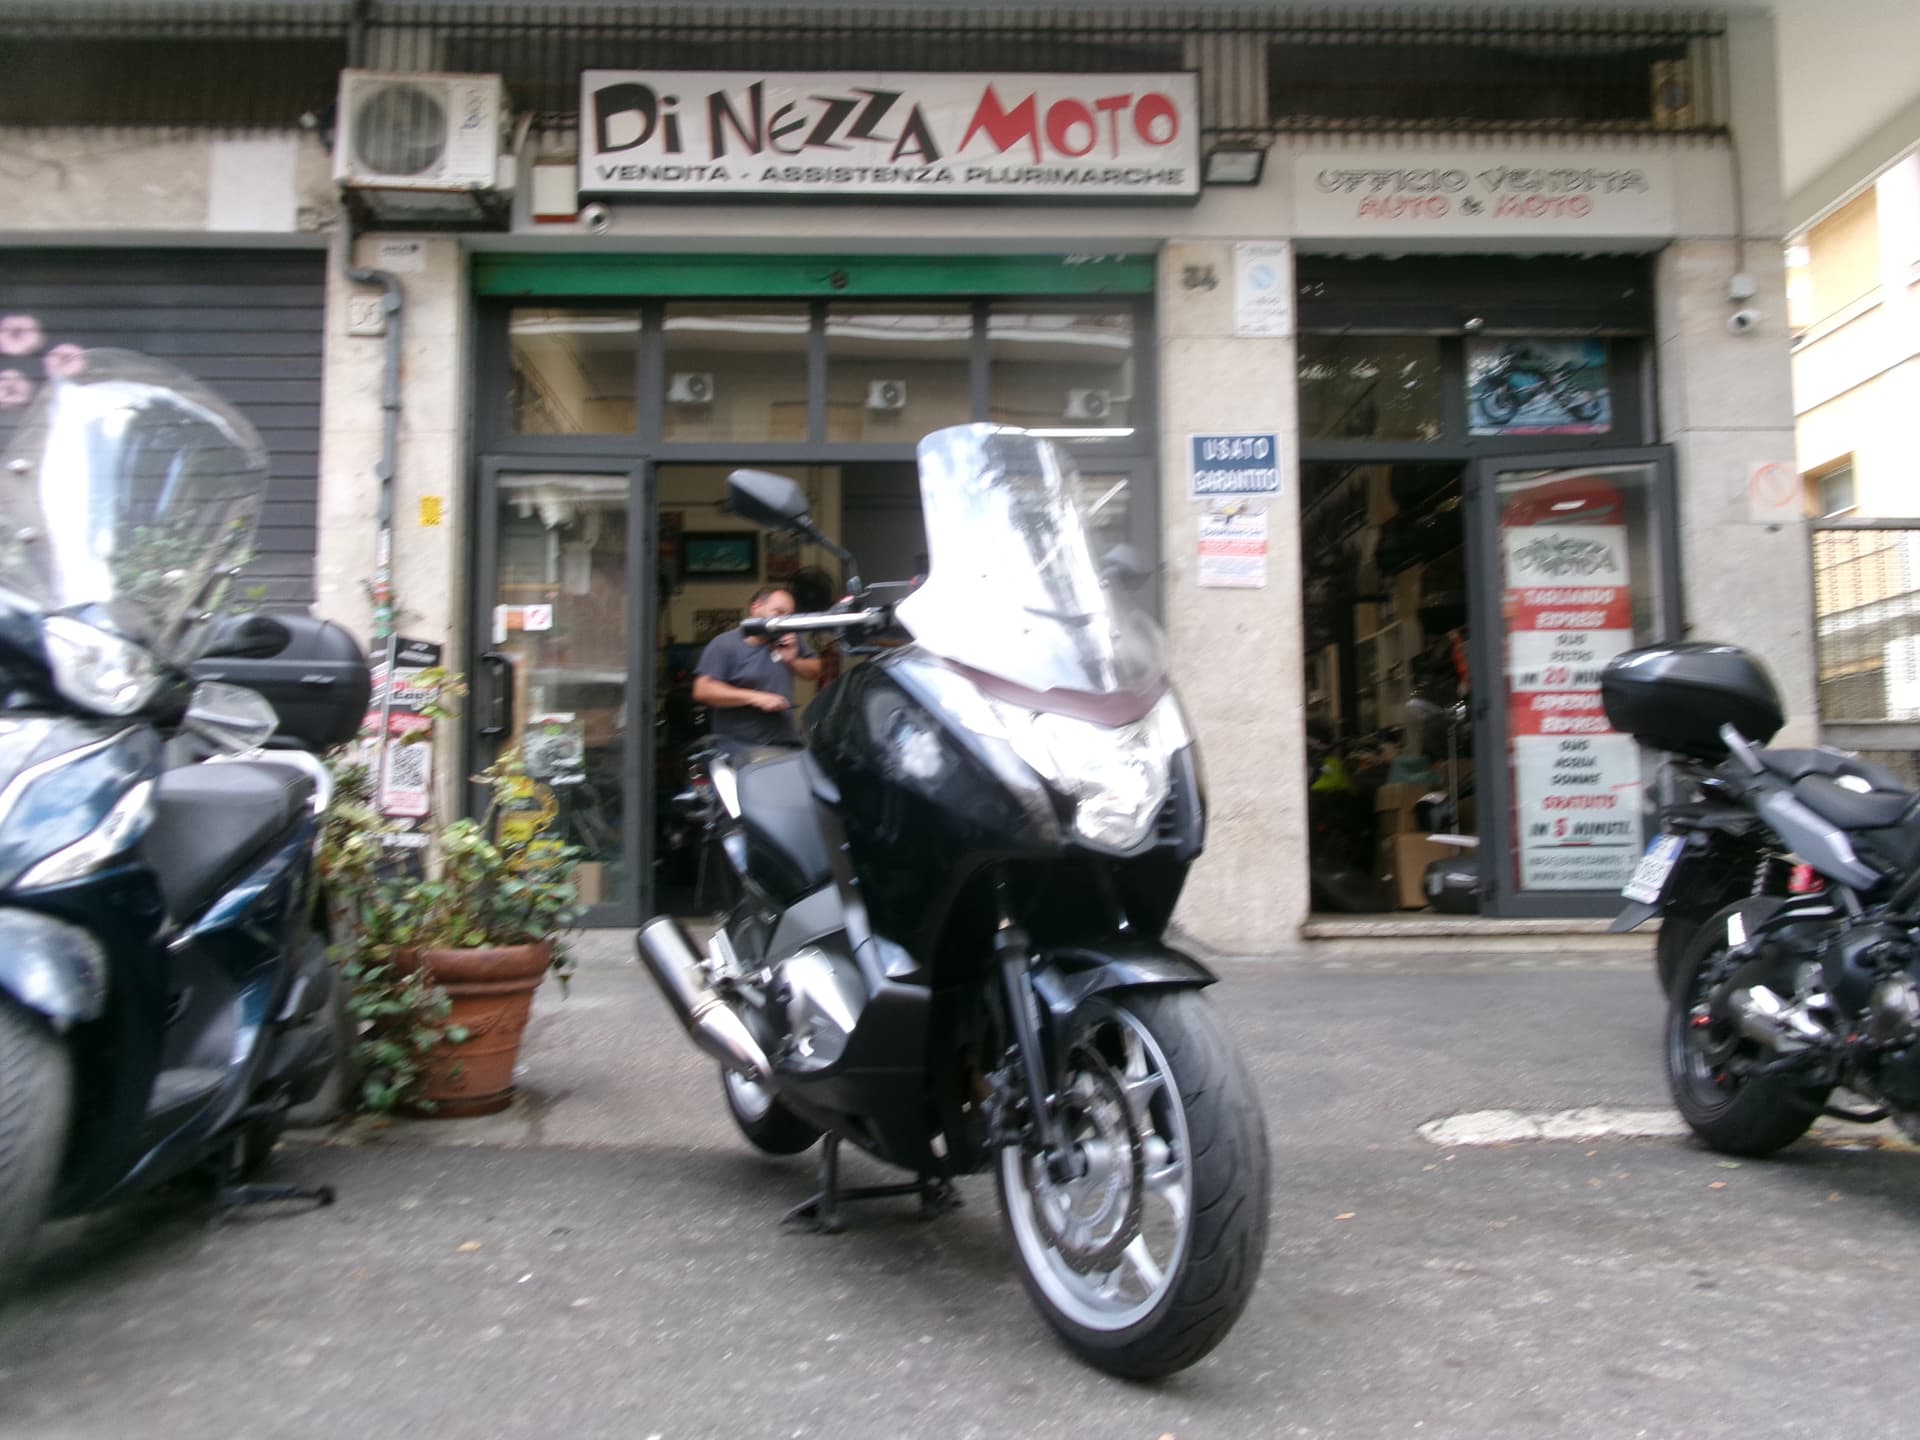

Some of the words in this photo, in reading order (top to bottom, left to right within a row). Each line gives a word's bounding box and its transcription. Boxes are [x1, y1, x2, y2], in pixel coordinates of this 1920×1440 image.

[957, 81, 1181, 166] MOTO
[595, 163, 730, 184] VENDITA
[760, 164, 955, 186] ASSISTENZA
[965, 166, 1187, 187] PLURIMARCHE
[1314, 167, 1471, 194] UFFICIO
[1355, 195, 1450, 219] AUTO
[1458, 195, 1485, 217] &
[1491, 194, 1594, 219] MOTO
[1202, 437, 1269, 461] USATO
[1194, 468, 1278, 492] GARANTITO
[1523, 590, 1615, 606] TAGLIANDO
[1535, 611, 1606, 628] EXPRESS
[1542, 666, 1570, 685] 20
[1541, 795, 1617, 810] GRATUITO
[1528, 821, 1550, 838] IN
[1552, 817, 1570, 838] 5
